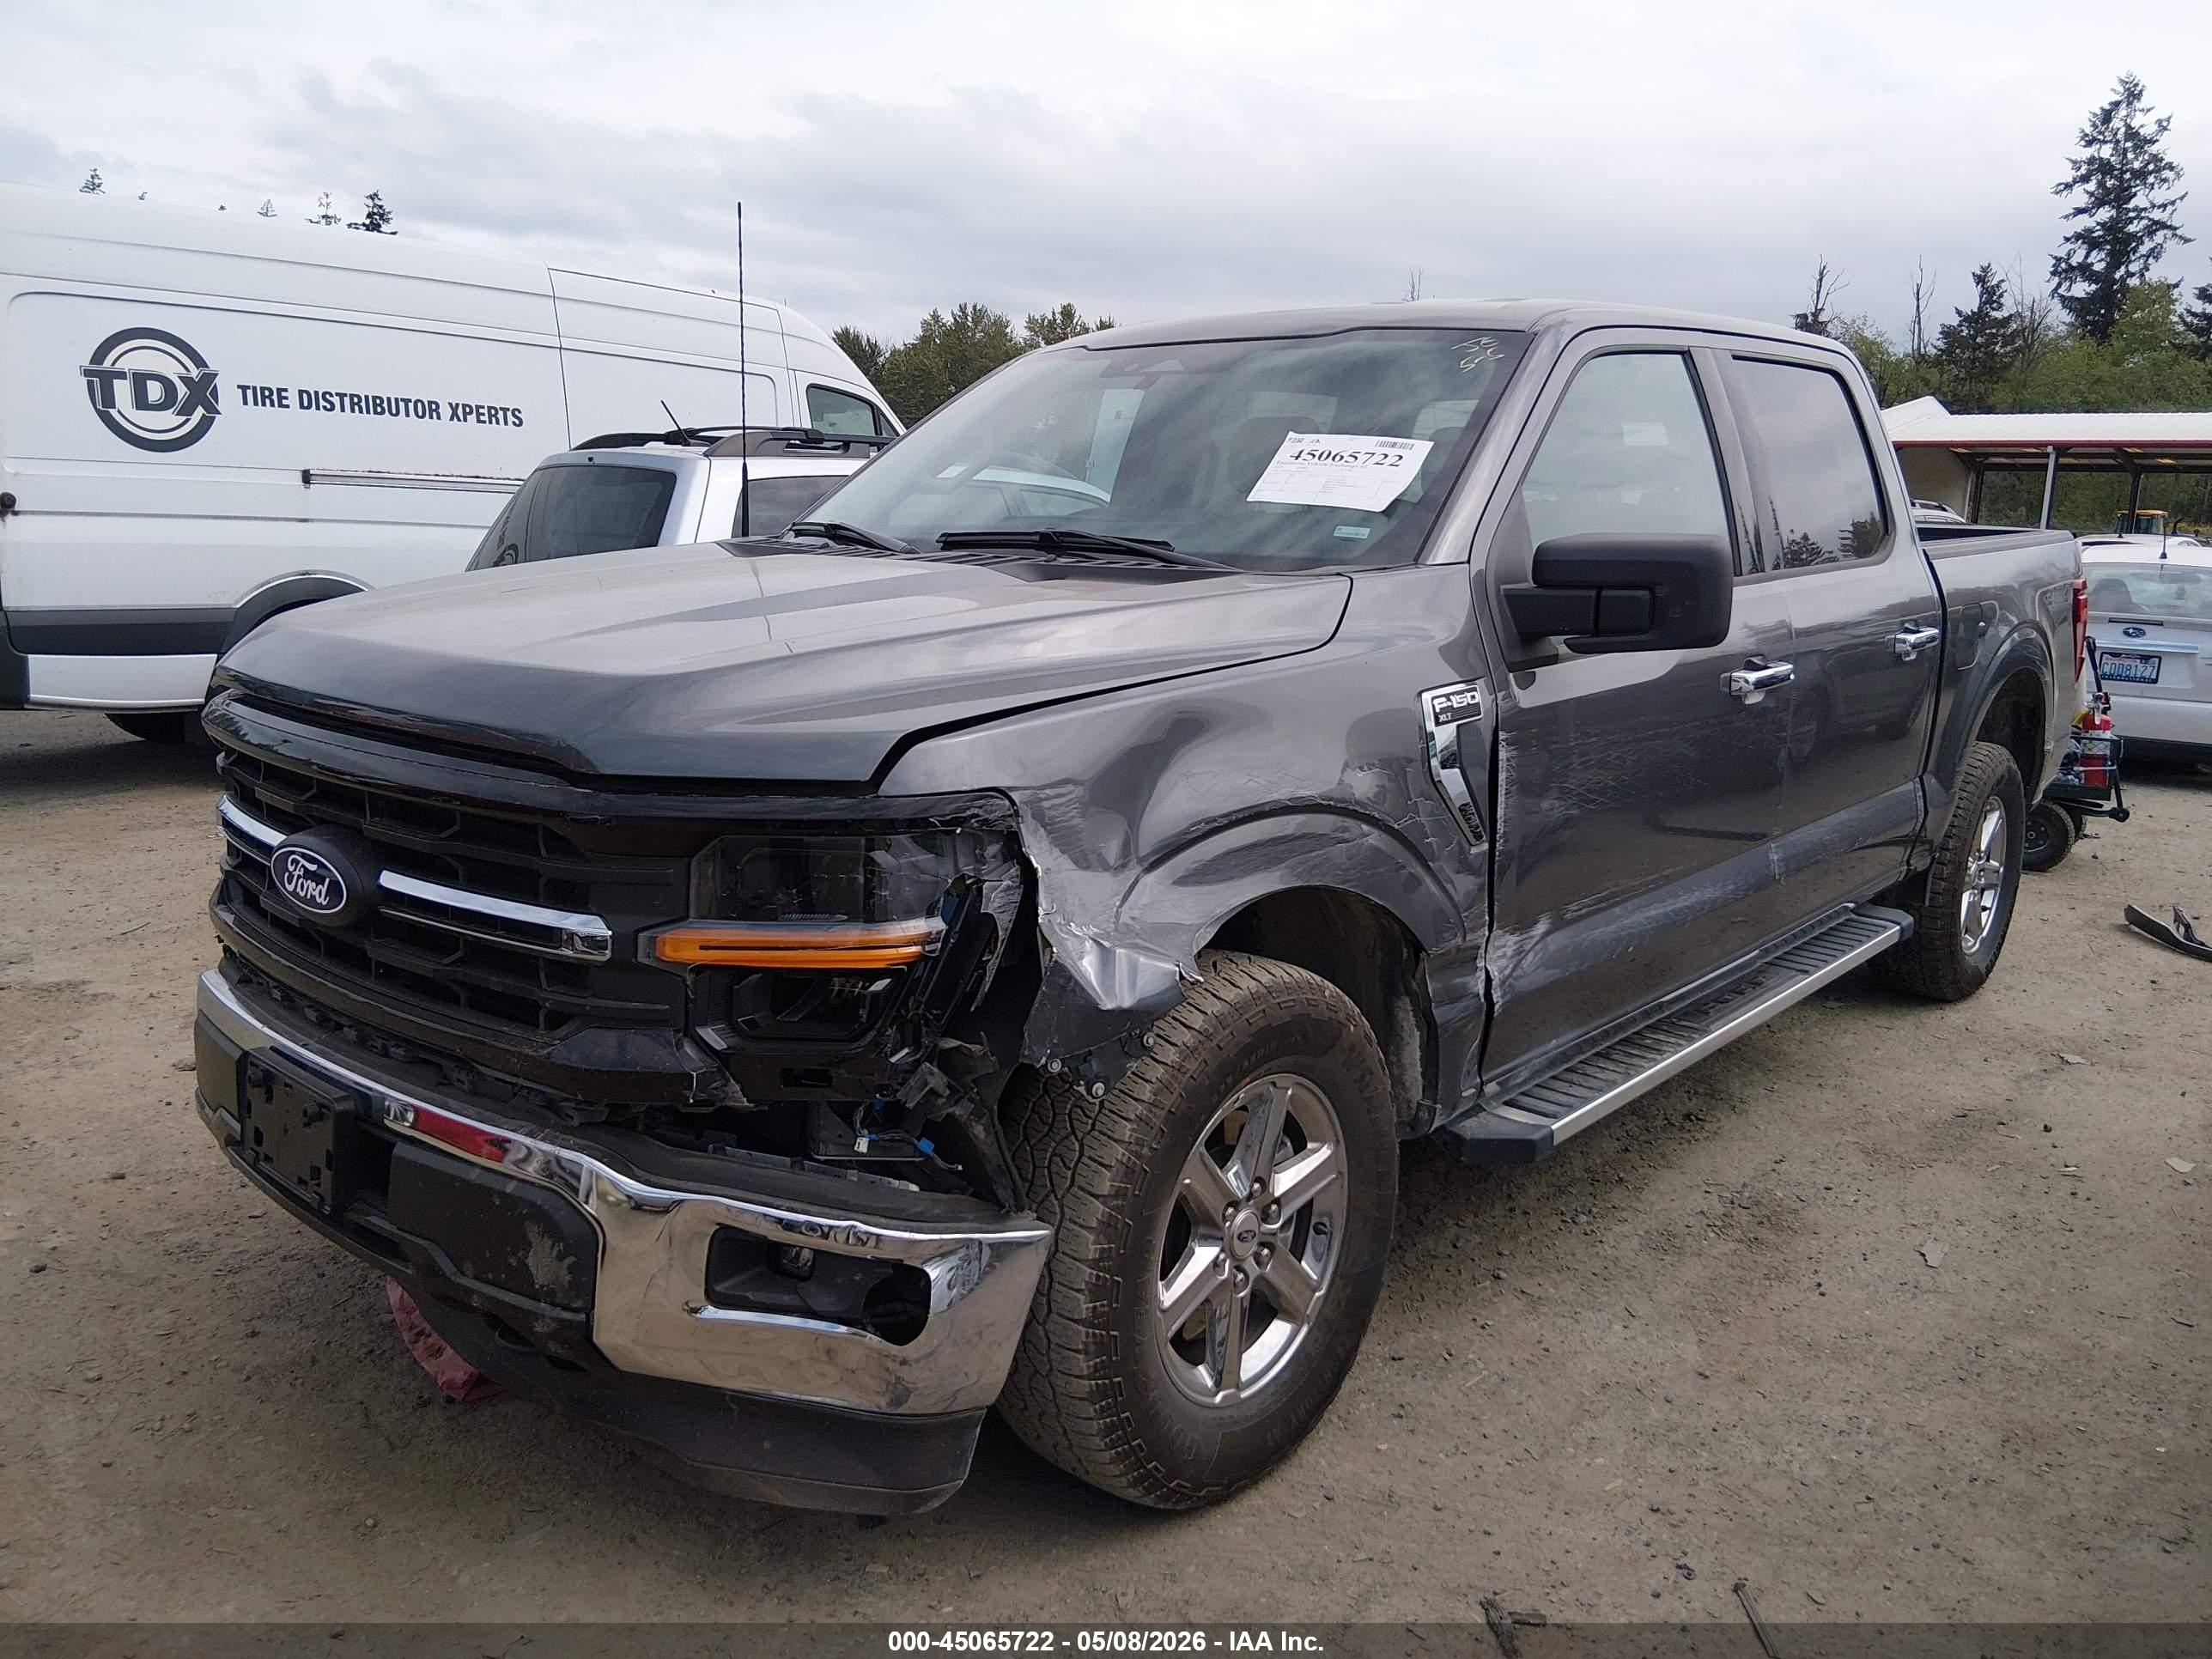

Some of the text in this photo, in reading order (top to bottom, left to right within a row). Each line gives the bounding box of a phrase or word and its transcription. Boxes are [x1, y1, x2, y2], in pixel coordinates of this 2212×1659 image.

[80, 366, 222, 416] TDX
[237, 384, 524, 428] TIRE DISTRIBUTOR XPERTS
[1289, 447, 1404, 468] 45065722
[1432, 691, 1480, 713] F-150
[1438, 713, 1452, 722] XLT
[284, 854, 330, 906] Ford
